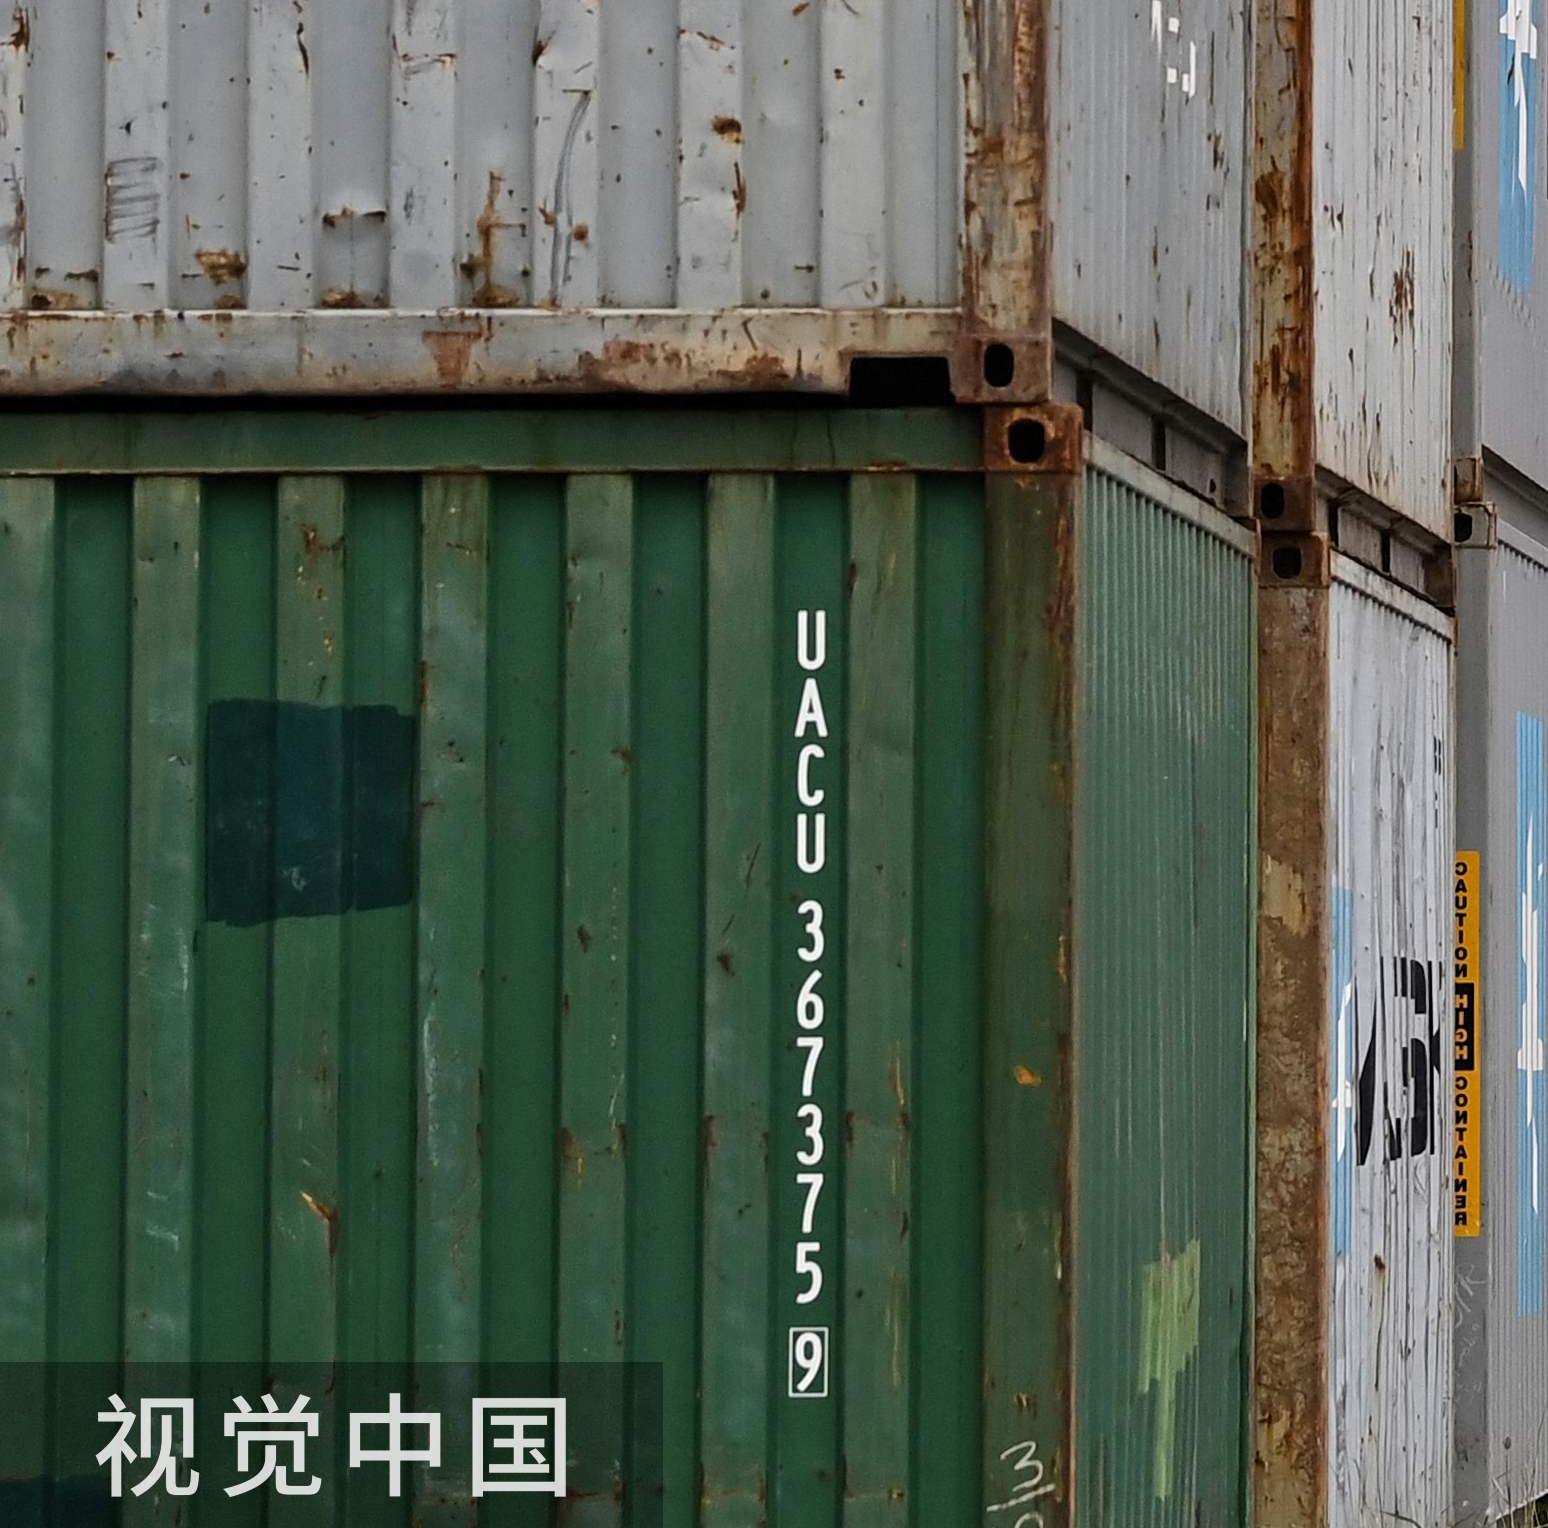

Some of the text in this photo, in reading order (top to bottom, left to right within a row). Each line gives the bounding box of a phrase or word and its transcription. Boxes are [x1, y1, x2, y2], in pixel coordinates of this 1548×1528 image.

[794, 610, 829, 1392] UACU 367375 9
